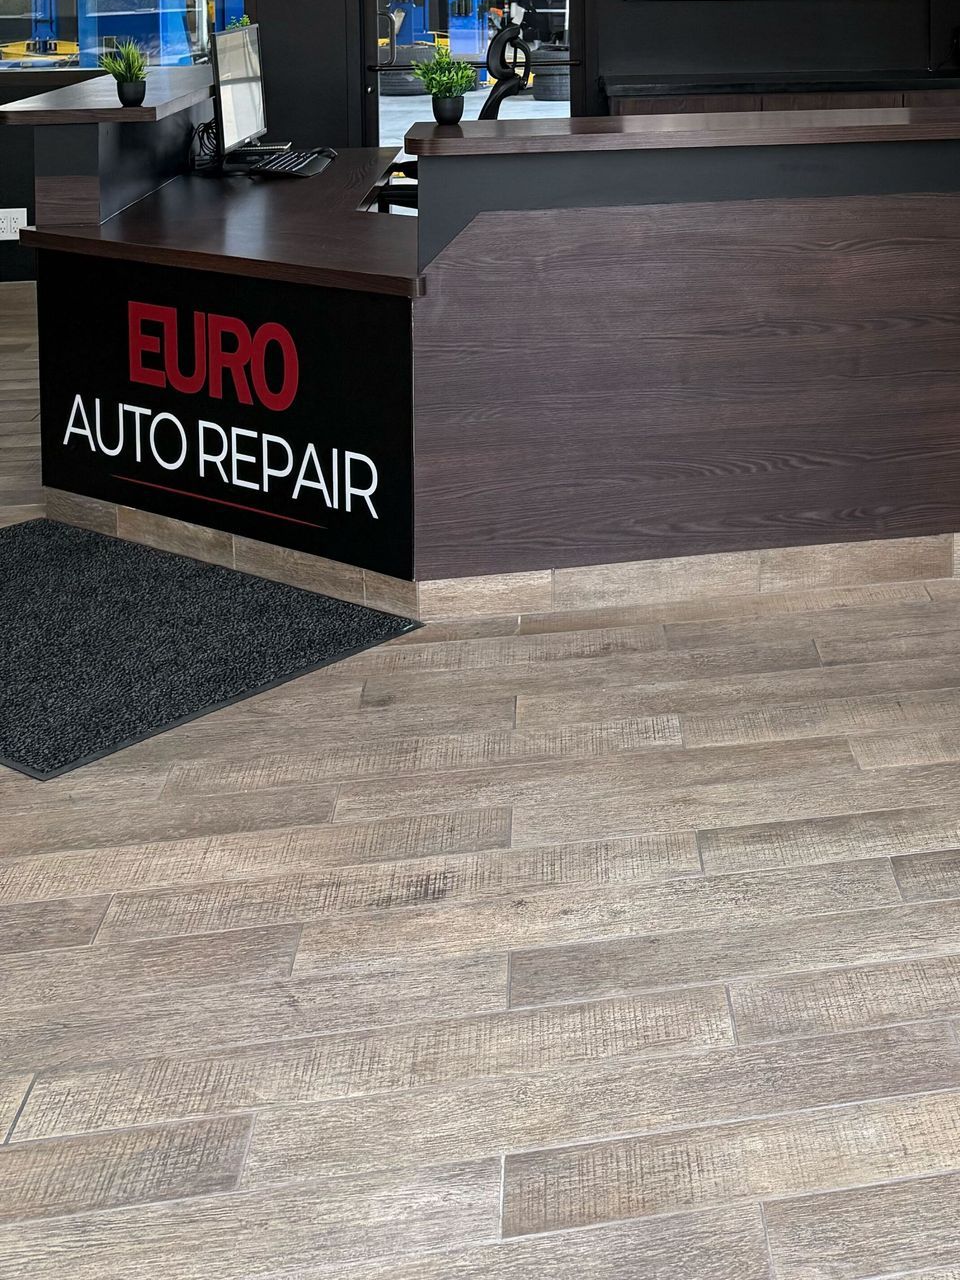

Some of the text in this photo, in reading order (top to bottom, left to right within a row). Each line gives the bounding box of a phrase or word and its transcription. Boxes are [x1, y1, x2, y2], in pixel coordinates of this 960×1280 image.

[127, 300, 299, 412] EURO
[63, 393, 379, 520] AUTO REPAIR
